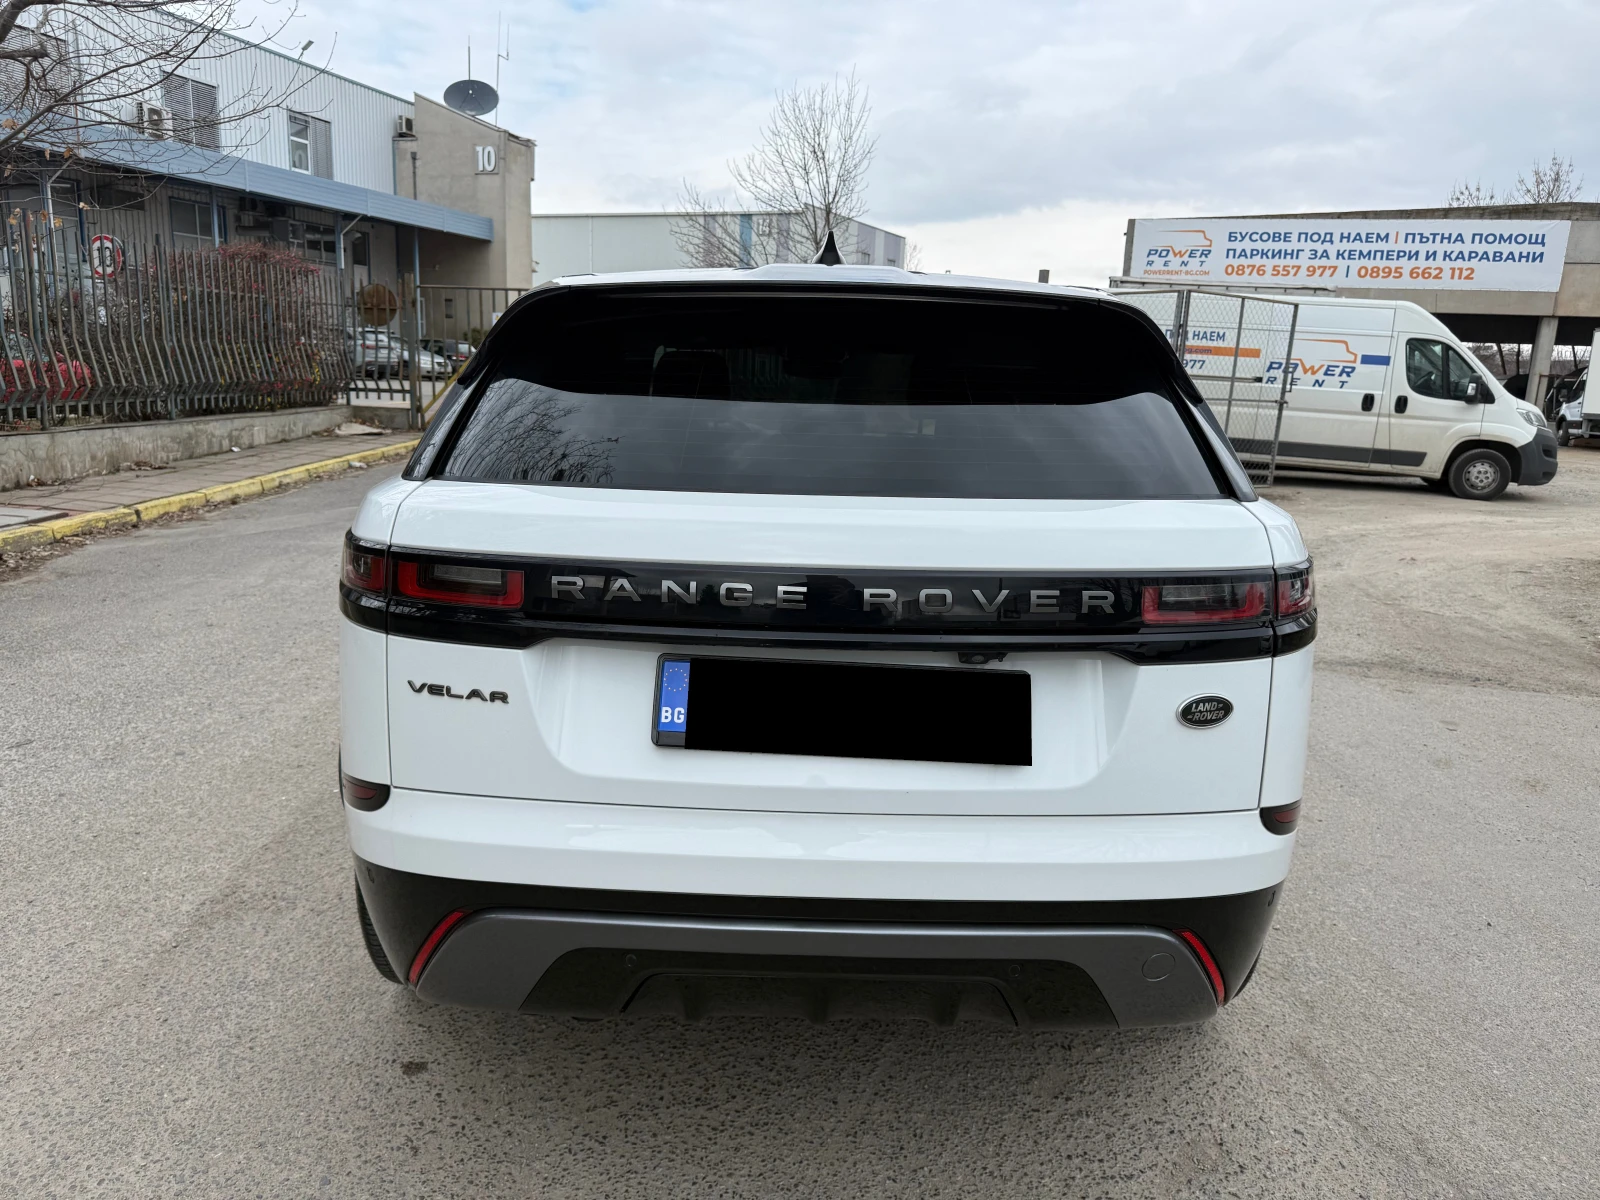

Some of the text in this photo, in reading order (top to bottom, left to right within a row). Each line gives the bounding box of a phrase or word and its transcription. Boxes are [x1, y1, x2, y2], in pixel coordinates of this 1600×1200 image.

[475, 145, 497, 172] 10
[1228, 231, 1546, 247] БУСОВЕ ПОД НАЕМ ПЪТНА ПОМОЩ
[1146, 248, 1212, 258] POWER
[1225, 248, 1545, 263] ПАРКИНГ ЗА КЕМПЕРИ И КАРАВАНИ
[1224, 264, 1475, 280] 0876 557 977 0895 662 112
[1192, 330, 1226, 342] НАЕМ
[1266, 361, 1356, 377] POWER
[1265, 376, 1348, 388] RENT
[551, 575, 1115, 614] RANGE ROVER
[407, 679, 509, 704] VELAR
[661, 706, 685, 723] BG
[1191, 702, 1218, 712] LAND
[1193, 710, 1224, 720] ROVER
